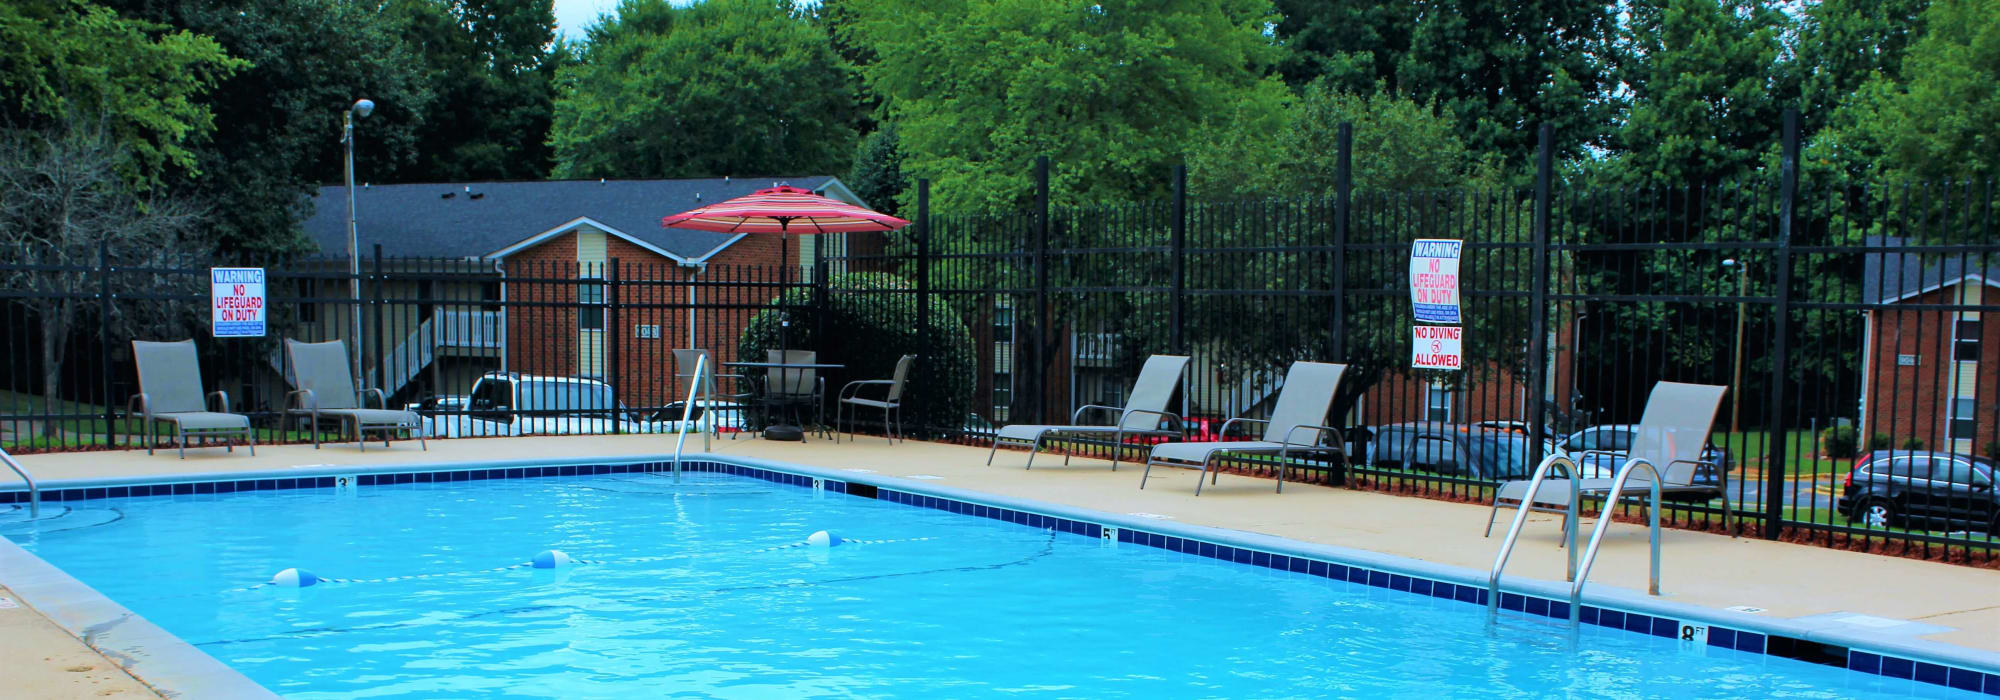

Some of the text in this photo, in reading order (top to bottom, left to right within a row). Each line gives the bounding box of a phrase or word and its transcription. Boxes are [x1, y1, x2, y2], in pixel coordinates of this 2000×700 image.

[1415, 242, 1459, 258] WARNING
[1429, 259, 1440, 273] NO
[214, 270, 262, 283] WARNING
[1413, 273, 1456, 289] LIFEGUARD
[233, 284, 245, 296] NO
[1417, 288, 1452, 304] ON DUTY
[216, 296, 262, 309] LIFEGUARD
[222, 309, 257, 321] ON DUTY
[1415, 327, 1460, 340] NO DIVING
[1415, 353, 1459, 367] ALLOWED
